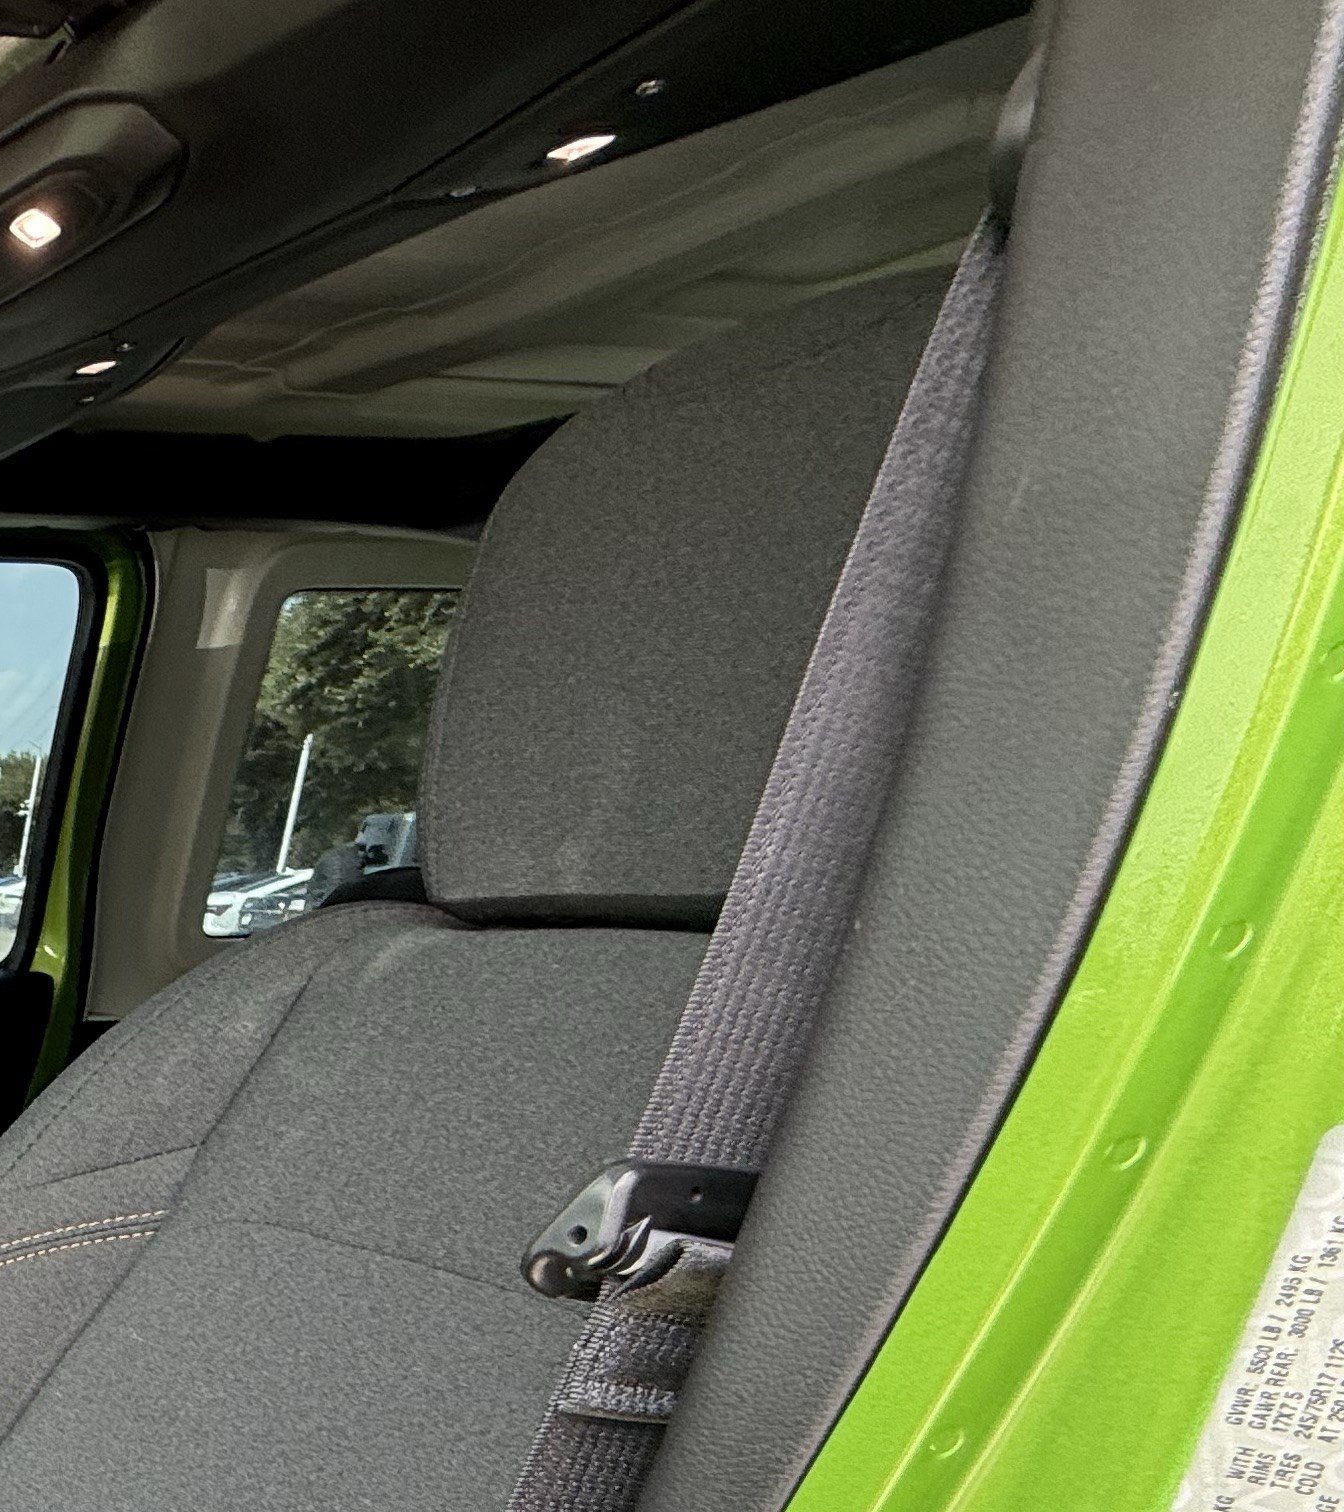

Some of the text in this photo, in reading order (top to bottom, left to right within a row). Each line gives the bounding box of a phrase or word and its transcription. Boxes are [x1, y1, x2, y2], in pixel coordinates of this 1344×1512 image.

[1224, 1446, 1256, 1479] WITH
[1246, 1453, 1277, 1484] RIMS
[1269, 1452, 1303, 1489] TIRES
[1293, 1462, 1325, 1494] COLD
[1212, 1494, 1235, 1512] KG
